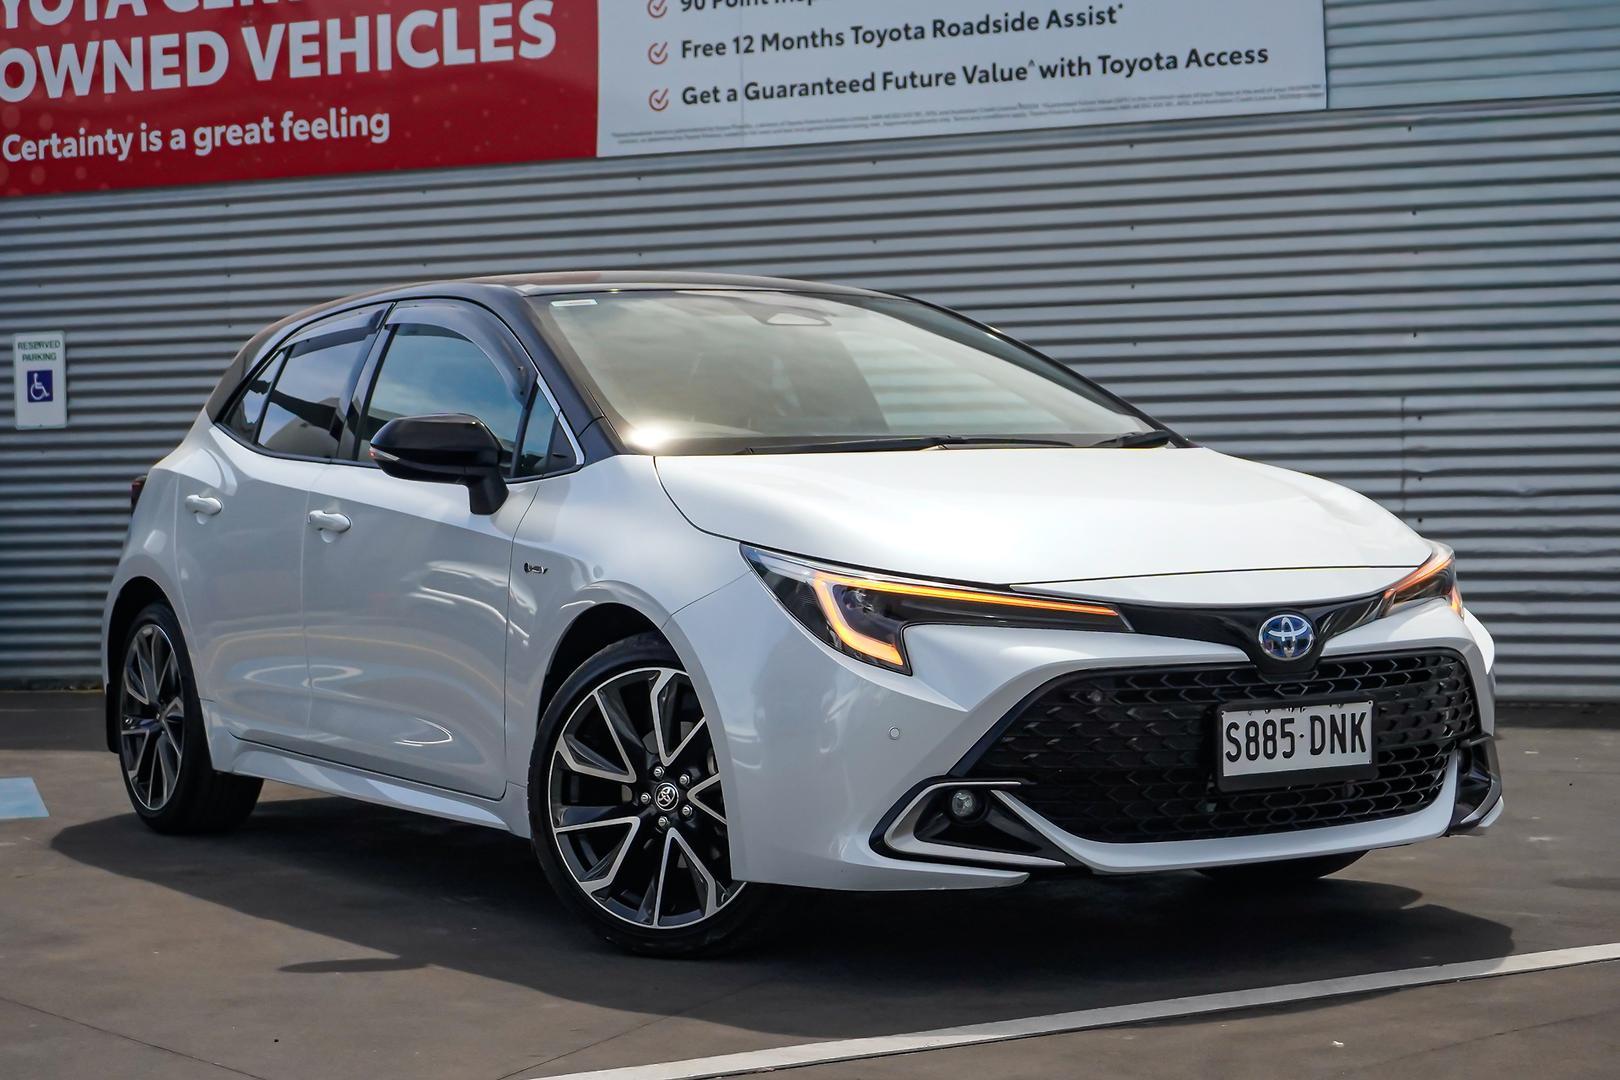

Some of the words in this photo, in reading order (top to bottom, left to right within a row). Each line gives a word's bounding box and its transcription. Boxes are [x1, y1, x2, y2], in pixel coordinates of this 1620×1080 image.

[0, 31, 230, 102] OWNED
[240, 0, 557, 81] VEHICLES
[681, 40, 726, 59] Free
[733, 34, 754, 54] 12
[761, 27, 845, 53] Months
[851, 23, 925, 48] Toyota
[932, 11, 1039, 38] Roadside
[682, 85, 721, 105] Get
[727, 88, 737, 102] a
[744, 72, 875, 101] Guaranteed
[882, 71, 956, 91] Future
[1039, 56, 1091, 79] with
[1098, 52, 1178, 78] Toyota
[1185, 48, 1269, 69] Access
[2, 127, 134, 162] Certainty
[140, 122, 163, 152] is
[169, 128, 186, 150] a
[193, 116, 275, 156] great
[280, 106, 390, 144] feeling
[18, 340, 60, 349] RESERVED
[22, 352, 56, 361] PARKING
